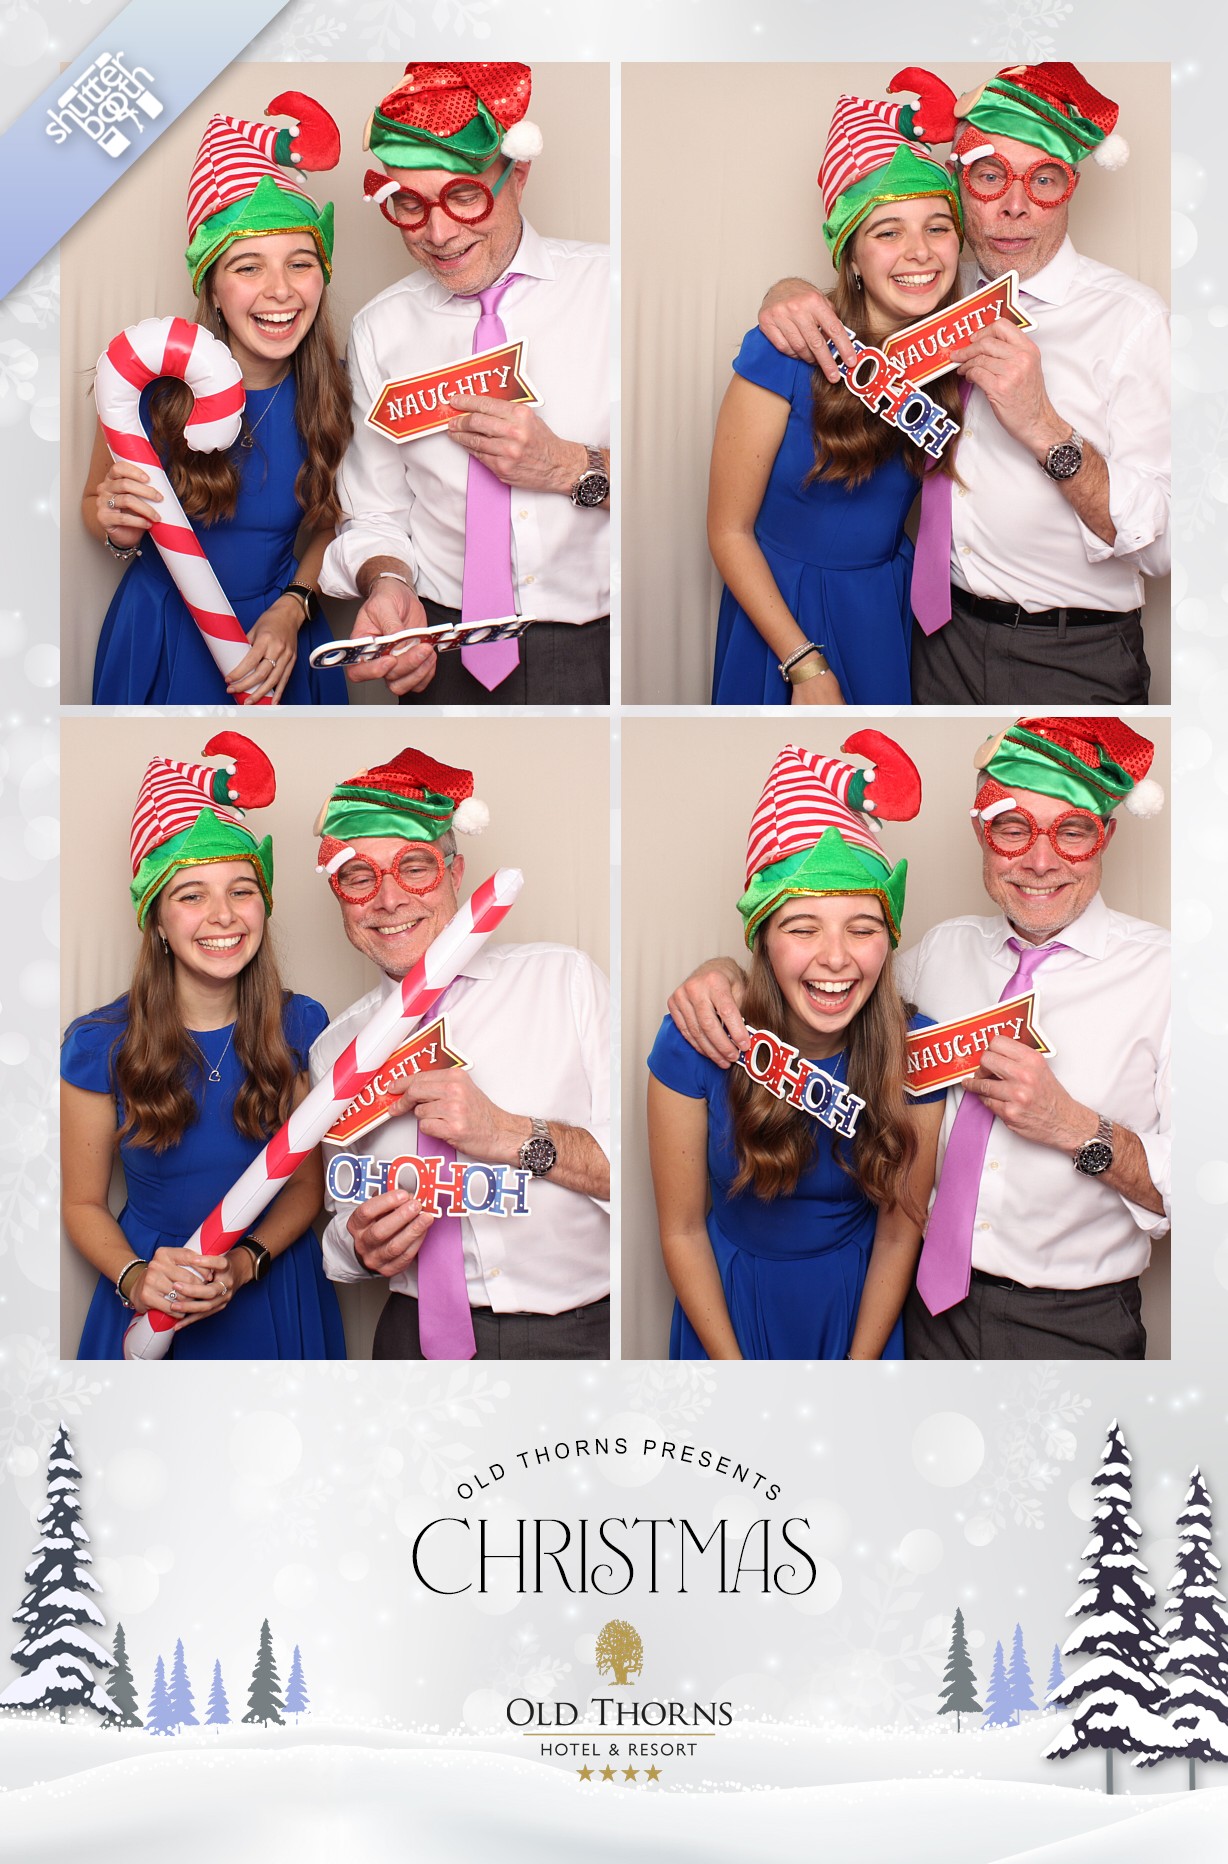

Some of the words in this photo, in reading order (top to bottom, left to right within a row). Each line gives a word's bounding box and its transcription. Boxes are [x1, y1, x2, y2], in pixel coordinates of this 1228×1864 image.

[889, 299, 1004, 371] NAUGHTY
[386, 365, 512, 421] NAUGHTY
[906, 1017, 1024, 1074] NAUGHTY
